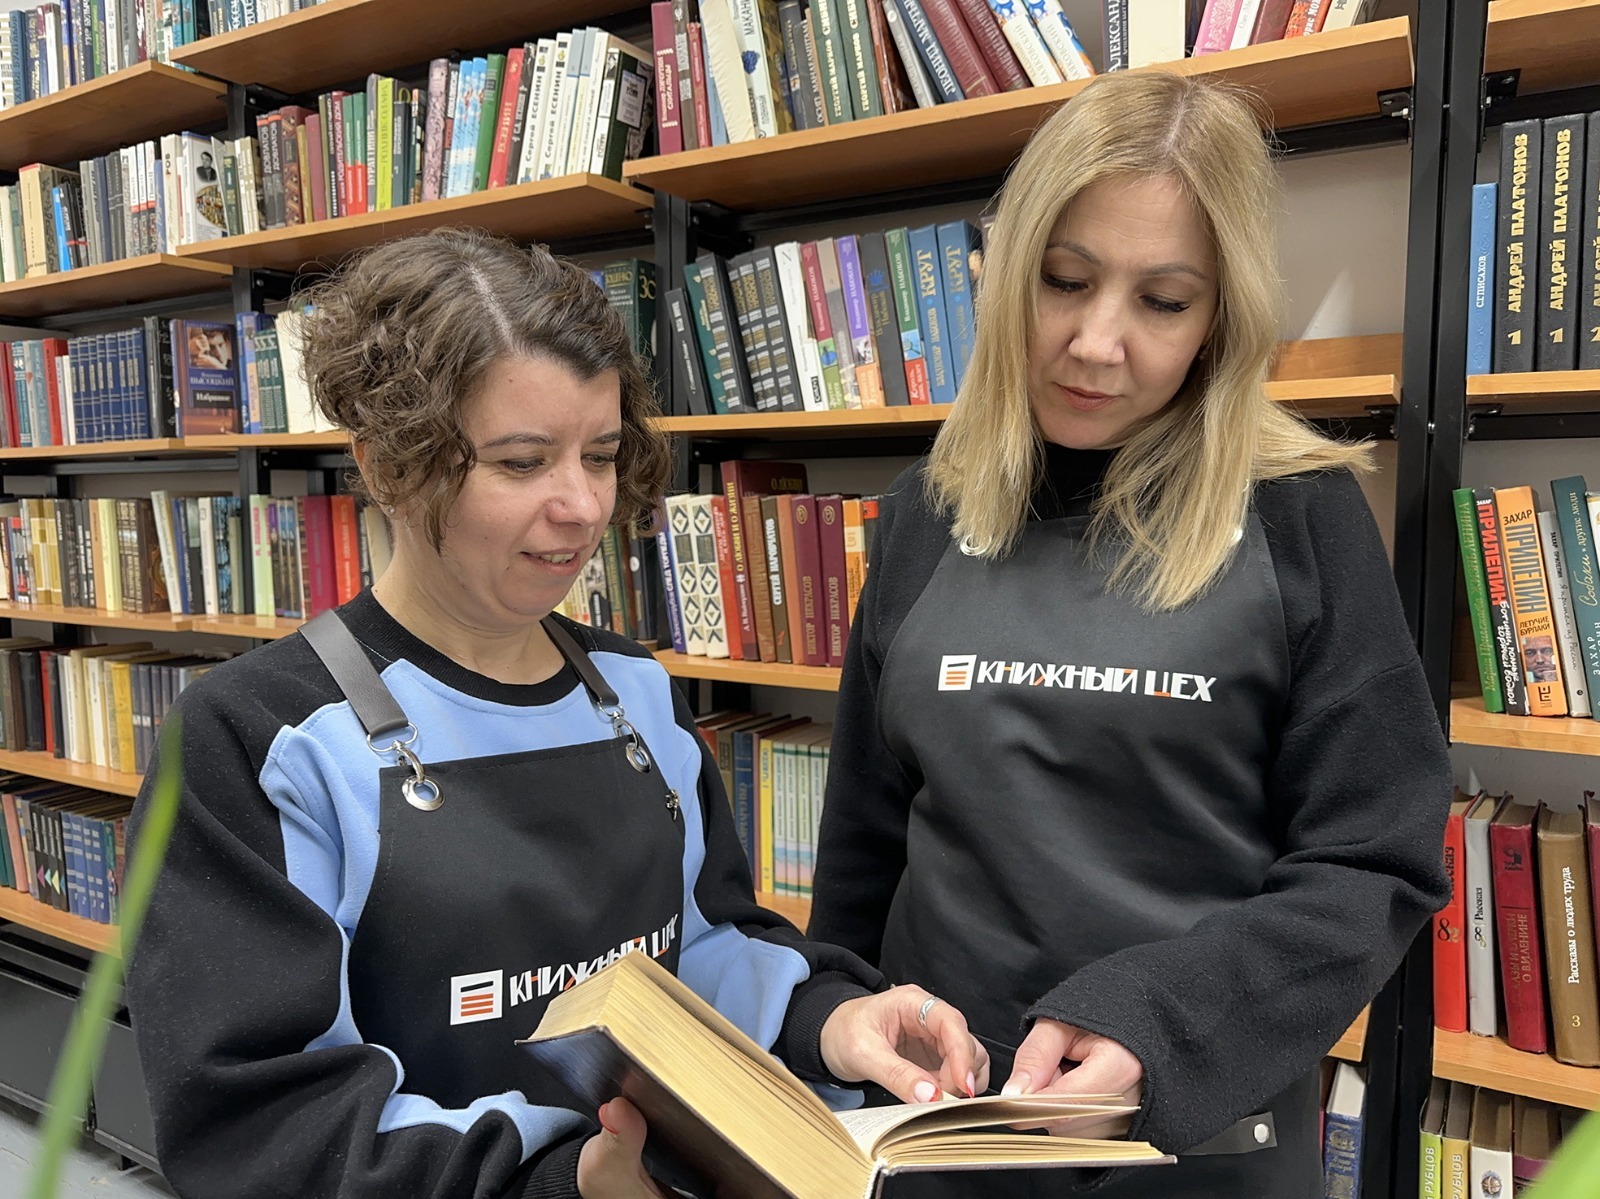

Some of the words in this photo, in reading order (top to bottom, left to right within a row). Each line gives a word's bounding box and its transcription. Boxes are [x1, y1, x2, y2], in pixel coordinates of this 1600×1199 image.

[824, 39, 836, 75] МАРКОВ
[851, 32, 864, 68] МАРКОВ
[663, 64, 674, 109] СКИТАЛЬЦЫ
[924, 43, 956, 95] ЛЕОНИД
[828, 76, 841, 116] ГЕОРГИЙ
[855, 70, 870, 111] ГЕОРГИЙ
[333, 101, 341, 120] ДОМ
[497, 102, 513, 153] ЕСЕНИН
[525, 124, 536, 161] Сергей
[531, 75, 542, 118] ЕСЕНИН
[544, 120, 556, 158] Сергей
[550, 71, 562, 114] ЕСЕНИН
[813, 96, 824, 123] ОСИП
[261, 126, 272, 174] ДОВЛАТОВ
[271, 121, 281, 171] ДОВЛАТОВ
[334, 121, 345, 181] РОДИТЕЛЬСКИЙ
[1511, 133, 1528, 236] ПЛАТОНОВ
[1553, 128, 1571, 233] ПЛАТОНОВ
[806, 266, 820, 300] НАБОКОВ
[845, 261, 857, 297] НАБОКОВ
[894, 252, 906, 288] НАБОКОВ
[919, 249, 936, 299] КРУГ
[948, 247, 965, 294] КРУГ
[1507, 242, 1524, 312] АНДРЕЙ
[1550, 238, 1566, 311] АНДРЕЙ
[813, 301, 826, 331] Владимир
[851, 298, 863, 328] Владимир
[900, 290, 911, 321] Владимир
[1508, 329, 1522, 345] 1
[1550, 327, 1564, 343] 1
[190, 376, 235, 387] ВЫСОЦКИЙ
[726, 482, 736, 514] ЖИЗНИ
[1570, 492, 1581, 512] люди
[1458, 501, 1478, 552] ЛЕНИНА
[1503, 510, 1533, 526] ЗАХАР
[1574, 513, 1588, 547] другие
[661, 531, 669, 569] ТОРПЕДЫ
[732, 532, 742, 563] ЛЮБВИ
[765, 518, 779, 576] НАРОВЧАТОВ
[1478, 505, 1503, 607] ПРИЛЕПИН
[1550, 531, 1559, 549] ЗАХАР
[666, 569, 674, 591] СЛЕД
[1504, 524, 1552, 615] ПРИЛЕПИН
[1553, 550, 1564, 579] ПРИЛЕПИН
[1573, 554, 1599, 608] Собаки
[770, 577, 783, 605] СЕРГЕЙ
[802, 575, 814, 618] НЕКРАСОВ
[828, 577, 839, 619] НЕКРАСОВ
[806, 622, 817, 654] ВИКТОР
[831, 623, 841, 656] ВИКТОР
[1519, 616, 1550, 630] ЛЕТУЧИЕ
[1520, 623, 1552, 637] БУРЛАКИ
[1588, 636, 1600, 676] ЗАХАР
[977, 660, 1138, 694] КНИЖНЫЙ
[1144, 670, 1217, 702] ЦЕХ
[1562, 866, 1576, 887] труда
[1475, 888, 1485, 921] Рассказ
[1563, 888, 1576, 929] людях
[1569, 930, 1576, 938] о
[1523, 973, 1531, 982] О
[1568, 936, 1580, 984] Рассказы
[1571, 1015, 1581, 1027] 3
[1424, 1147, 1436, 1192] РУБЦОВ
[1453, 1154, 1463, 1199] РУБЦОВ
